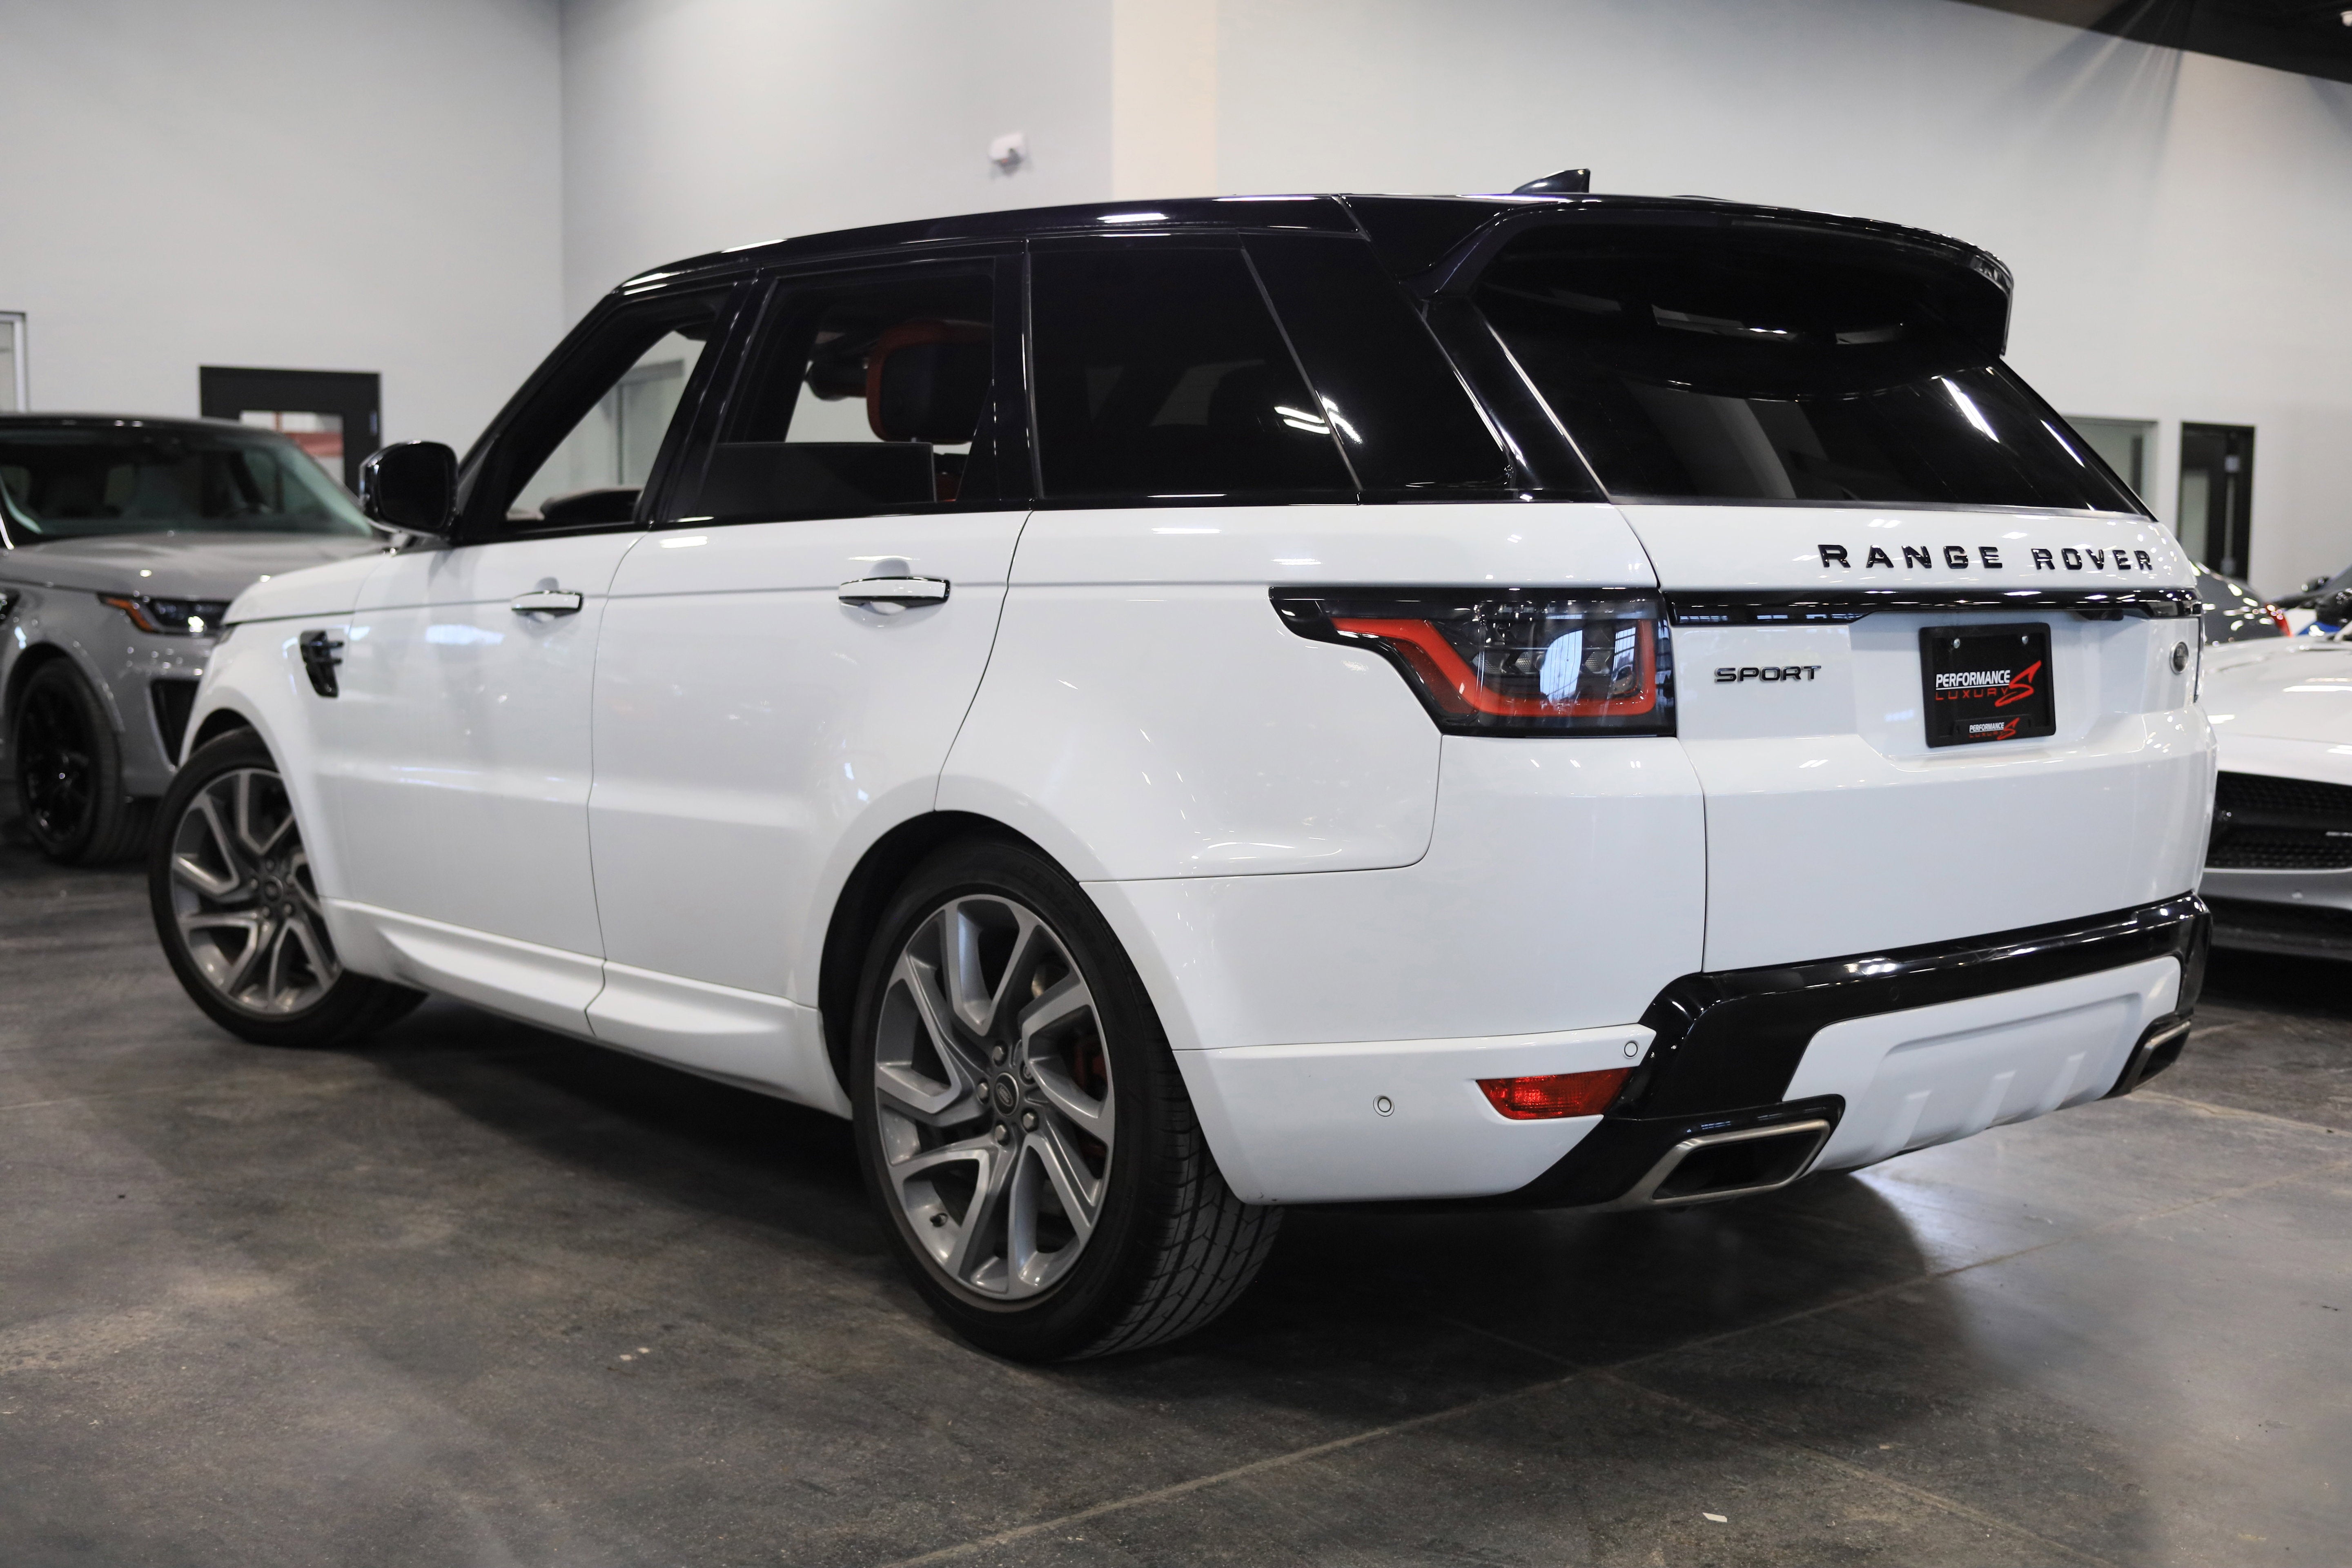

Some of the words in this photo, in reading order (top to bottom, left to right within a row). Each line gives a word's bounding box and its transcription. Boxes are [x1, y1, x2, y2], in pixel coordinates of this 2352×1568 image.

[1817, 544, 2003, 569] RANGE
[2031, 548, 2153, 571] ROVER
[1715, 665, 1821, 682] SPORT
[1936, 670, 2011, 688] PERFORMANCE
[1935, 688, 2009, 700] LUXURY
[1969, 722, 2004, 731] PERFORMANCE
